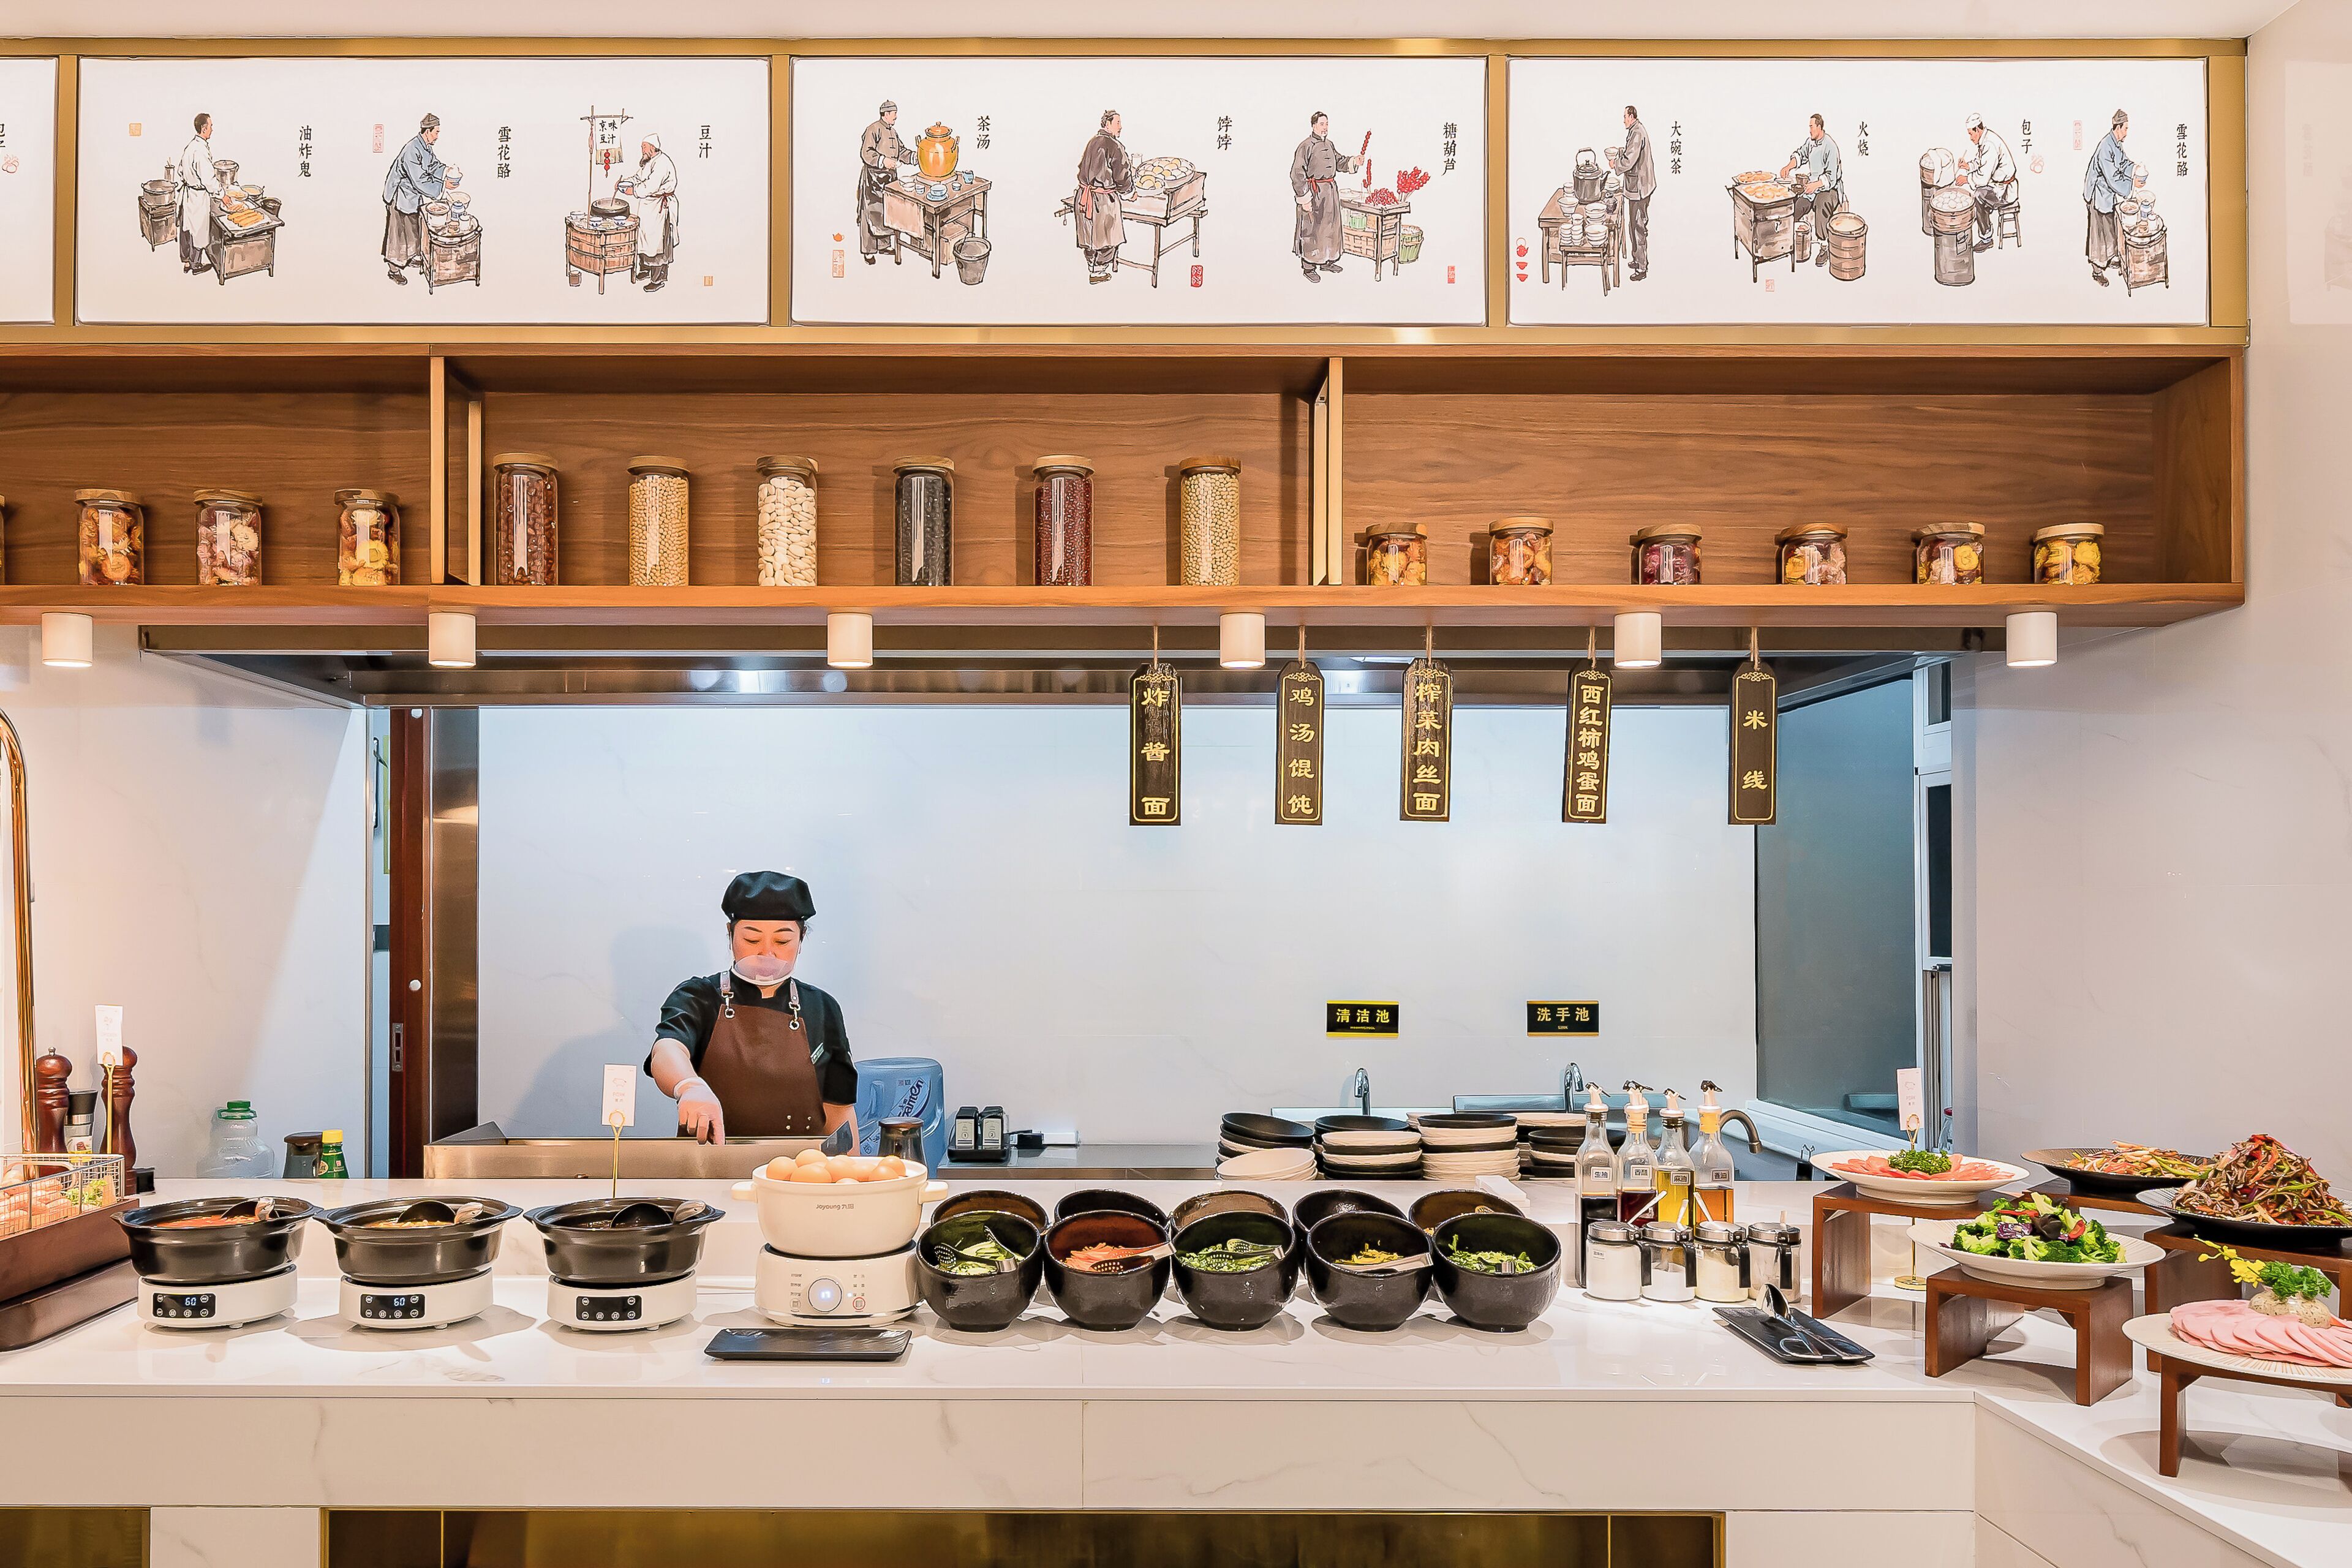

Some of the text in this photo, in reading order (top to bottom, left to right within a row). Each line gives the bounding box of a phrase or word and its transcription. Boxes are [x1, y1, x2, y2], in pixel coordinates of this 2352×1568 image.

[598, 119, 618, 132] 京味
[599, 134, 616, 145] 豆汁
[699, 124, 712, 159] 豆汁
[976, 115, 991, 150] 茶汤
[1216, 115, 1232, 151] 饽饽
[1857, 121, 1869, 156] 火烧
[2021, 119, 2033, 154] 包子
[298, 124, 312, 178] 油炸鬼
[497, 126, 511, 179] 雪花酪
[1442, 122, 1458, 176] 糖葫芦
[1670, 121, 1683, 175] 大碗茶
[2176, 123, 2188, 177] 雪花酪
[1141, 688, 1170, 815] 炸酱面
[1287, 687, 1315, 815] 鸡汤馄饨
[1413, 682, 1442, 812] 榨菜肉丝面
[1575, 684, 1605, 813] 西红柿鸡蛋面
[1742, 709, 1768, 790] 米线
[1336, 1008, 1389, 1023] 清洁池
[1537, 1007, 1589, 1022] 洗手池
[185, 1297, 197, 1306] 60
[394, 1297, 405, 1306] 60
